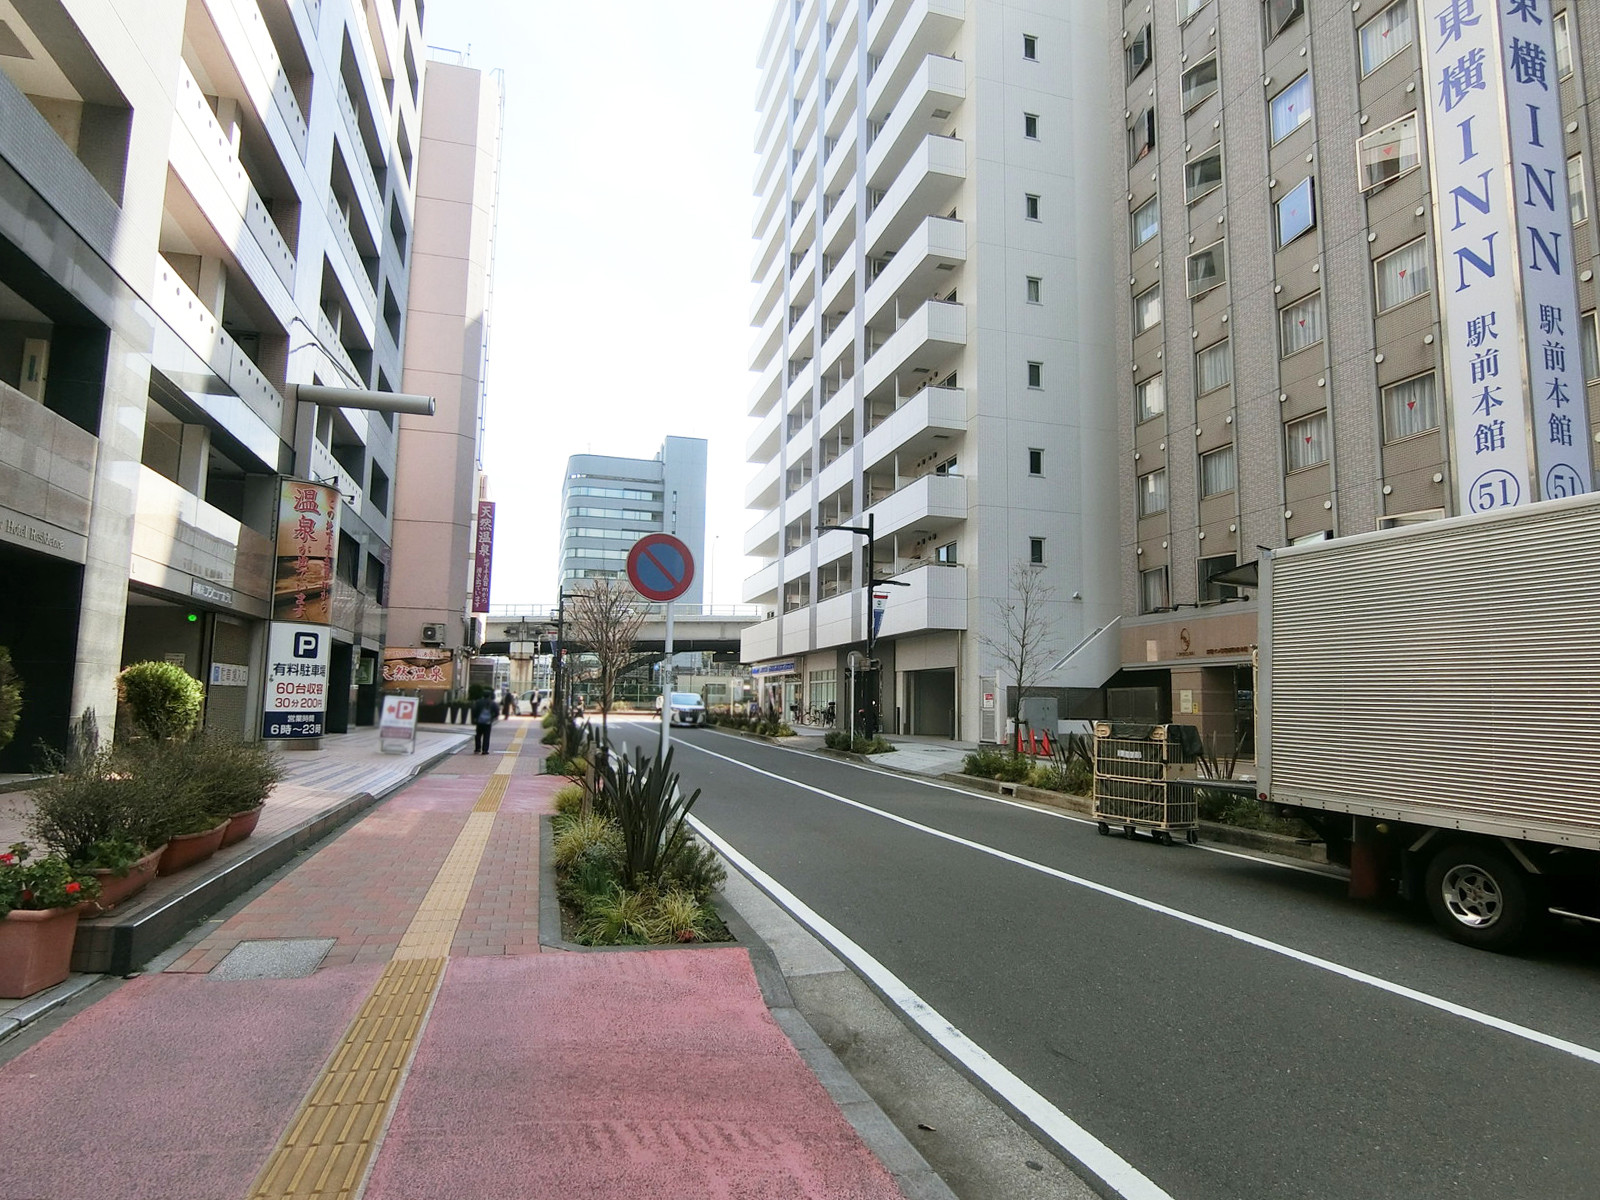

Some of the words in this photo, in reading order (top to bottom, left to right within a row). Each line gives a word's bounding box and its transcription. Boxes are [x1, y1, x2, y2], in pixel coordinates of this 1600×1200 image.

[1433, 0, 1499, 293] 東横INN
[1465, 310, 1506, 456] 駅前本館
[1538, 303, 1573, 447] 駅前本館
[1477, 479, 1511, 510] 51
[5, 519, 28, 538] Hotel
[298, 635, 317, 656] P
[273, 662, 326, 678] 有料駐車場
[276, 682, 324, 695] 60台収容
[274, 697, 323, 709] 30分200円
[287, 714, 315, 723] 営業時間
